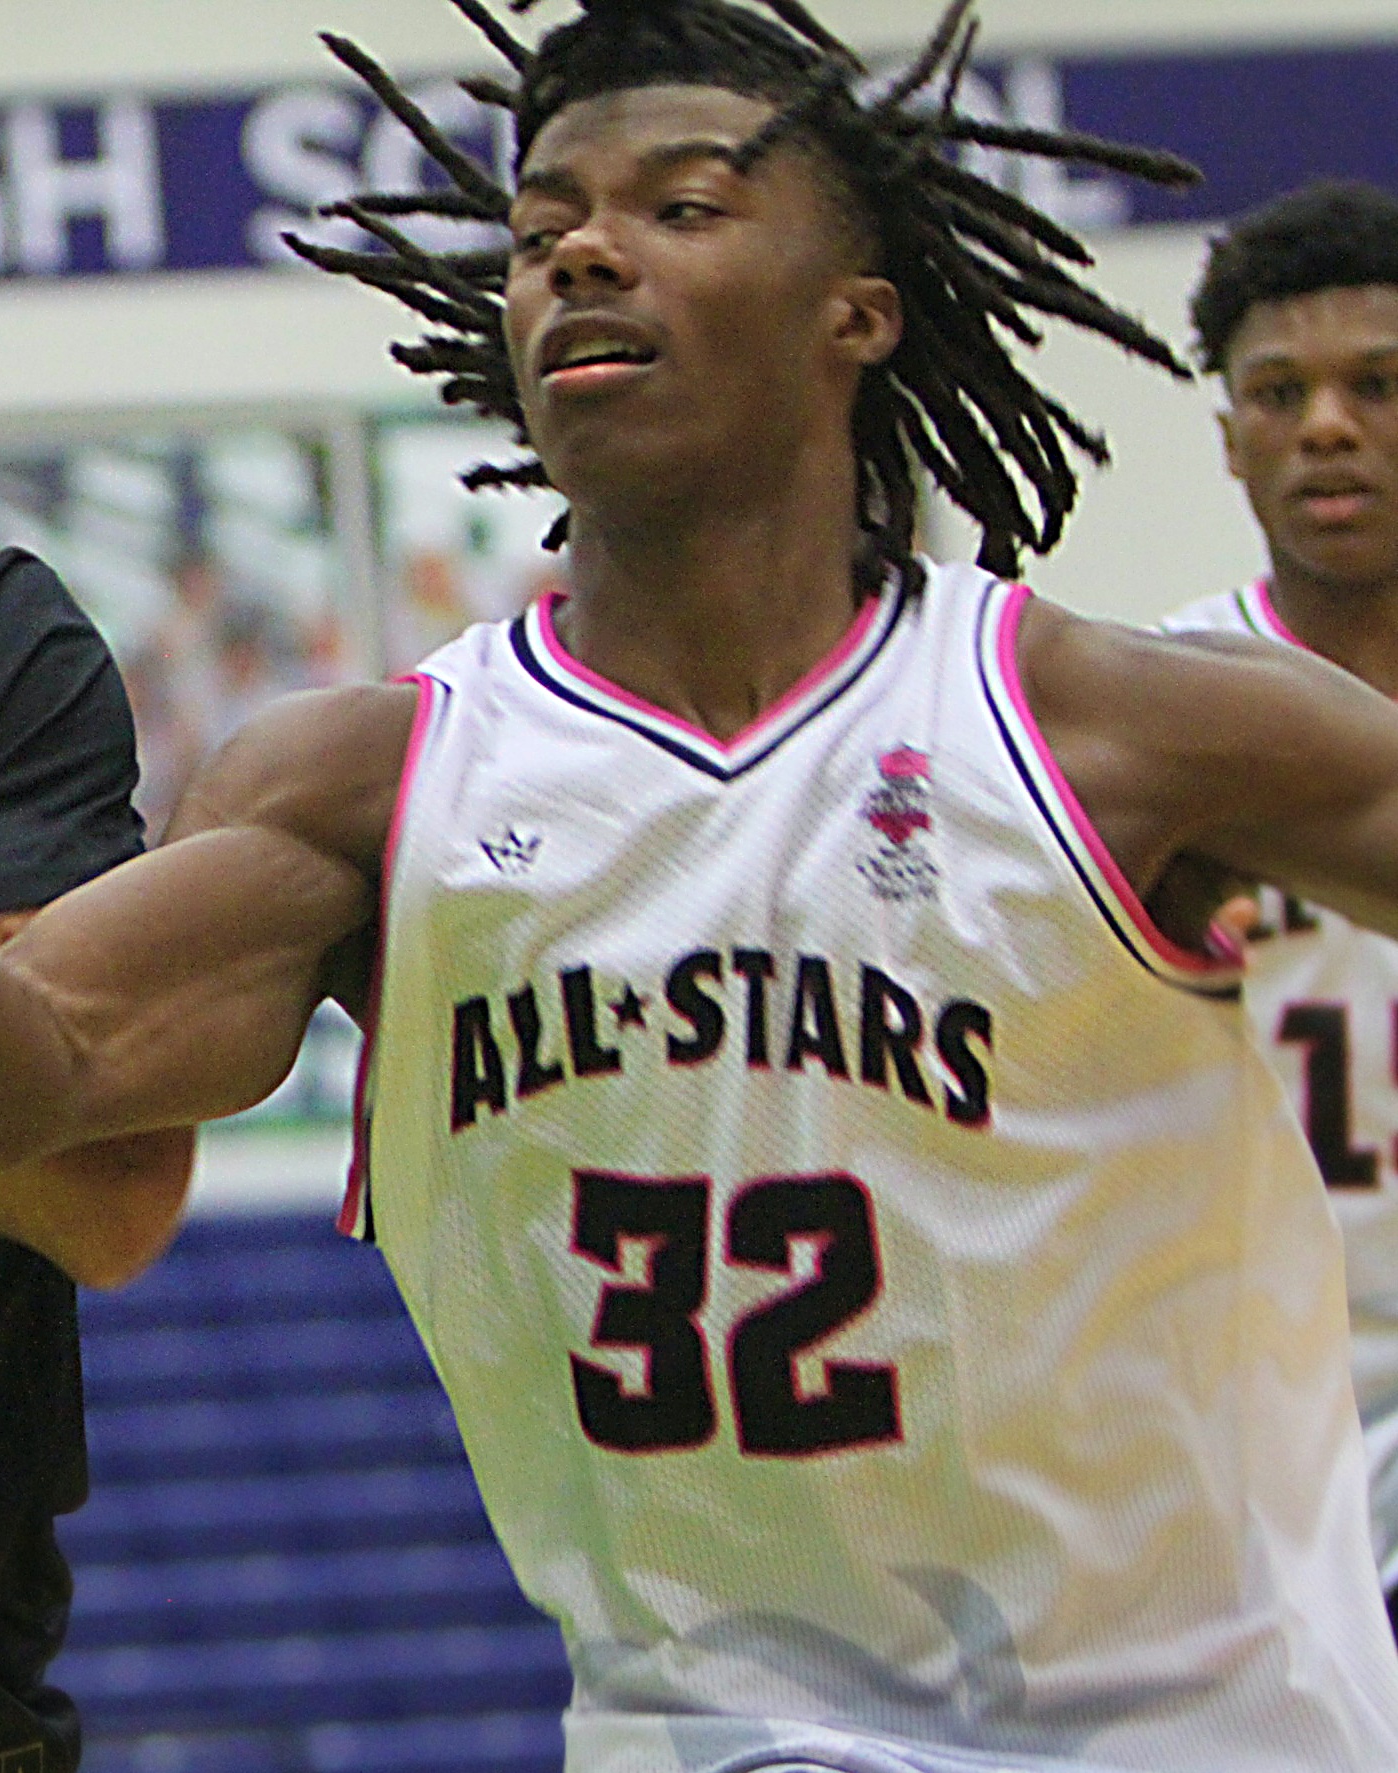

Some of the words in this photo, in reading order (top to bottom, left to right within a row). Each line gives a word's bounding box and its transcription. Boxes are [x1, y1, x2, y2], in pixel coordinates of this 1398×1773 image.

[450, 963, 623, 1135] ALL
[663, 945, 994, 1132] STARS
[1275, 998, 1398, 1192] 1
[569, 1166, 905, 1459] 32
